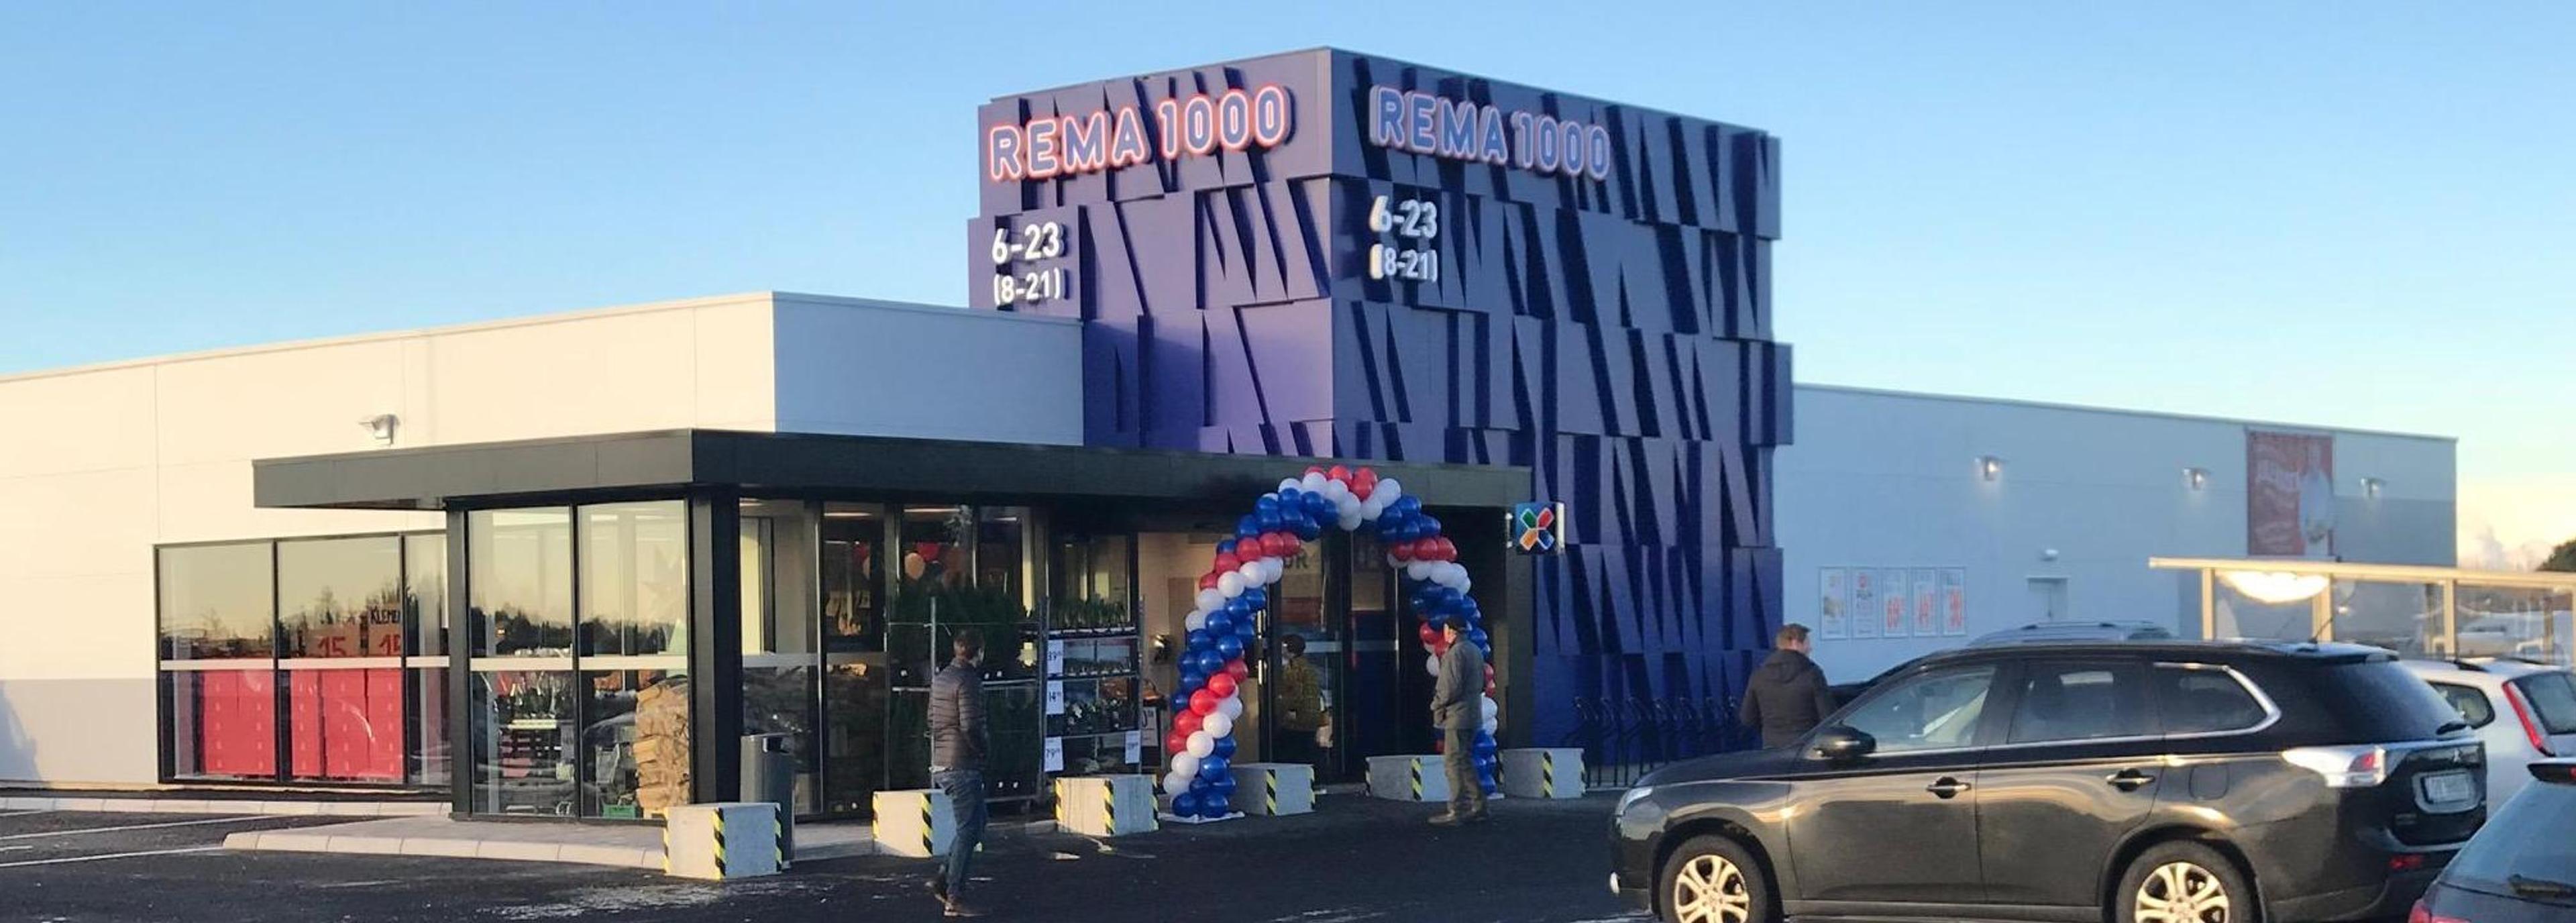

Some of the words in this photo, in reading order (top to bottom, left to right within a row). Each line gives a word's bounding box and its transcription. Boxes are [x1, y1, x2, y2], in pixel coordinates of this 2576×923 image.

[990, 106, 1146, 181] REMA
[1157, 85, 1287, 159] 1000
[1370, 85, 1508, 165] REMA
[1511, 111, 1611, 180] 1000
[1369, 195, 1438, 238] 6-23
[992, 221, 1060, 264] 6-23
[1369, 243, 1438, 283] (8-21)
[994, 266, 1061, 306] (8-21)
